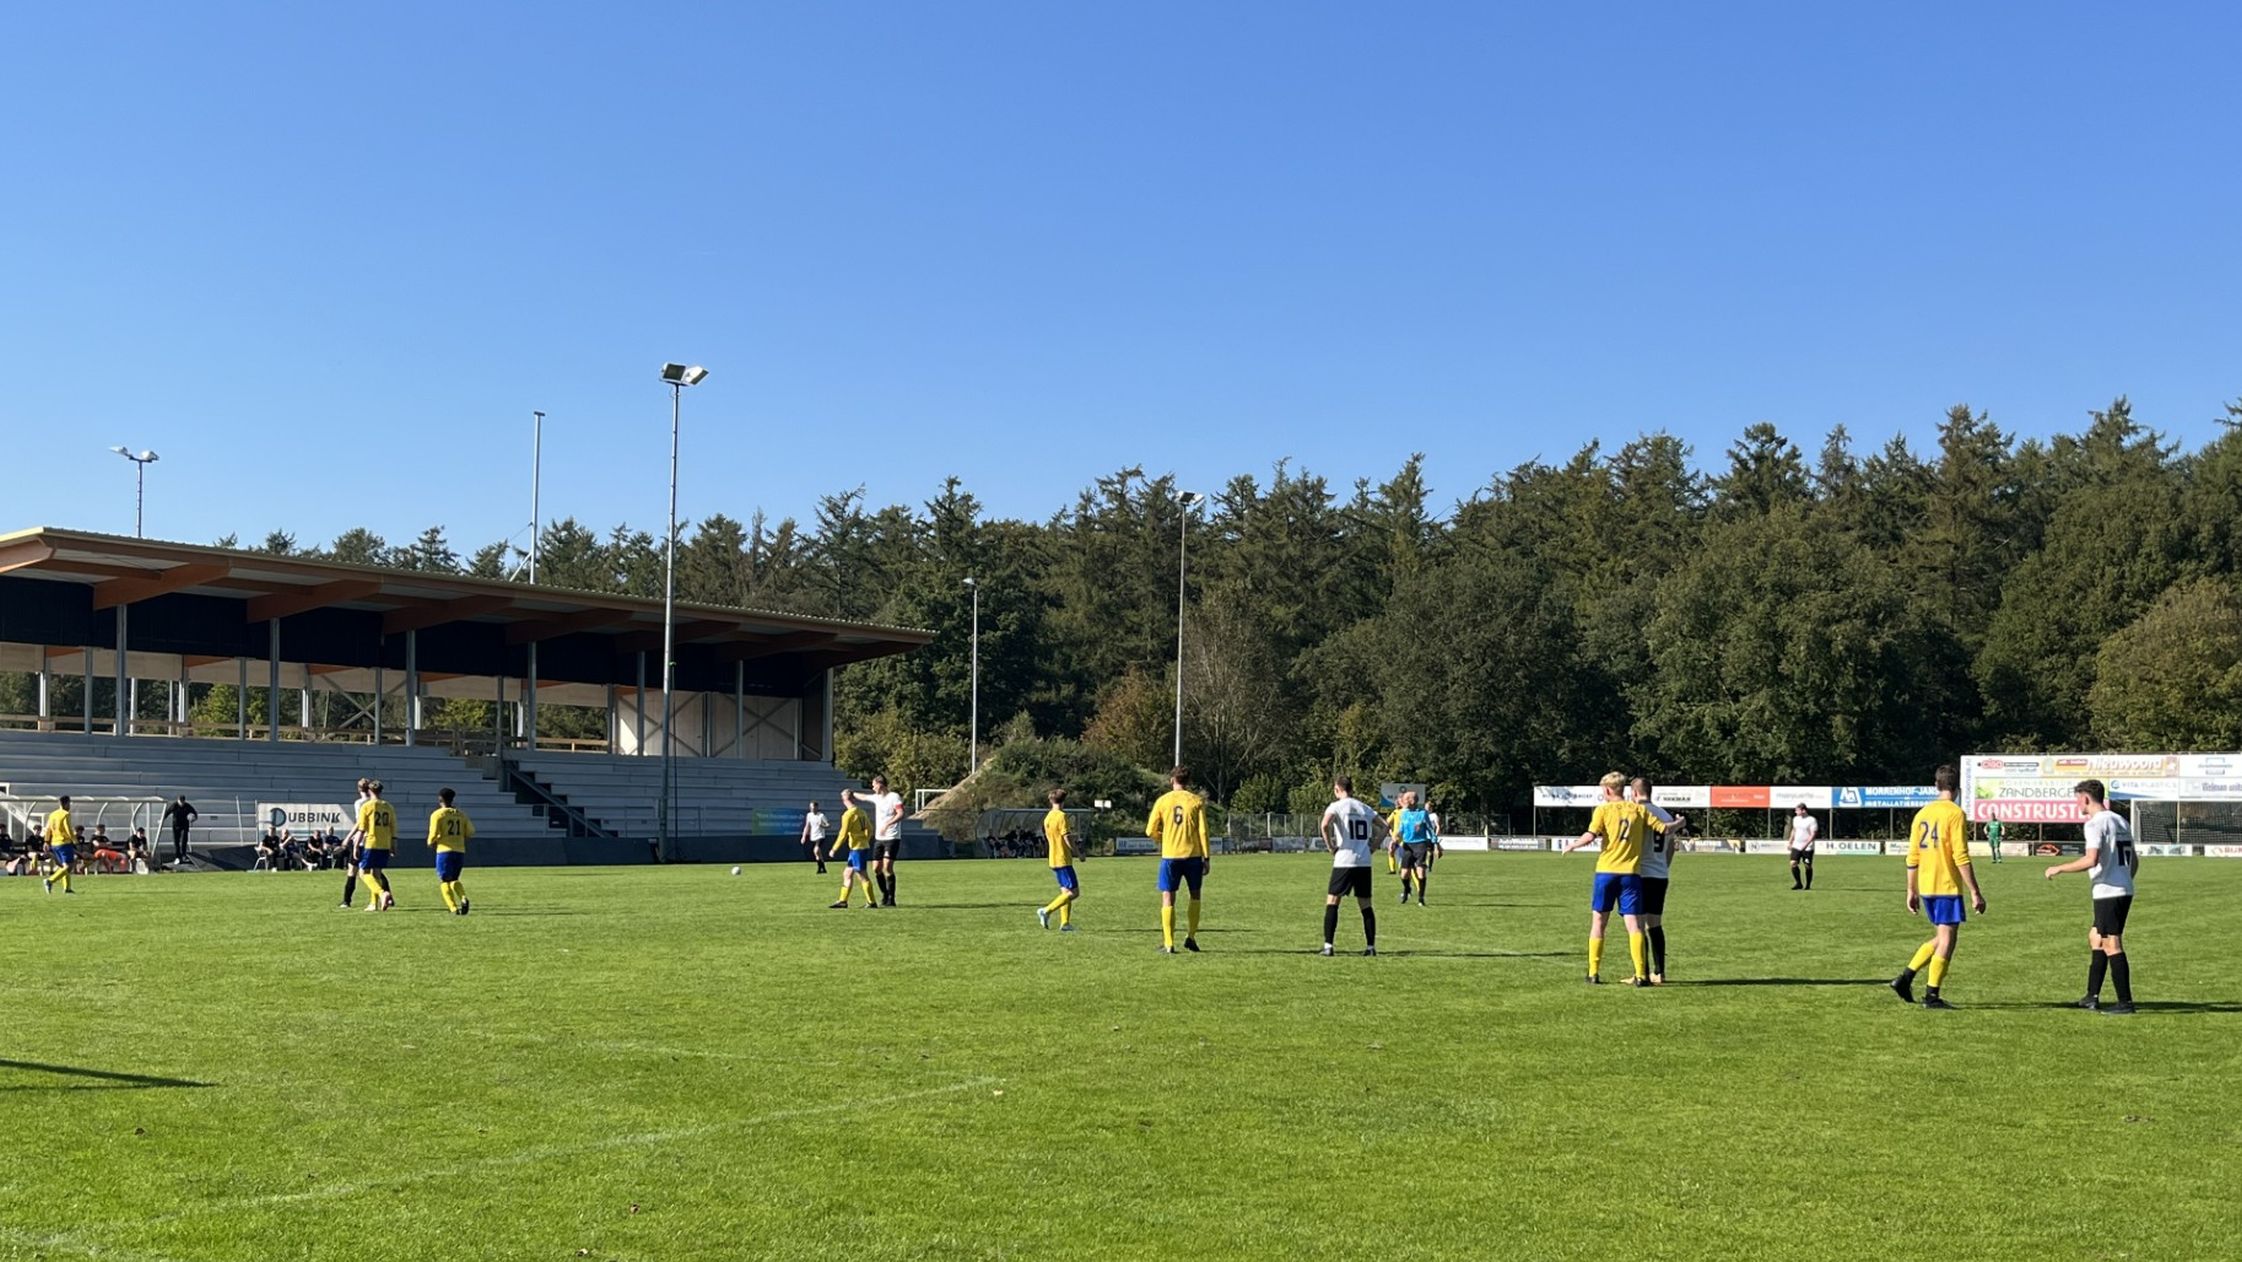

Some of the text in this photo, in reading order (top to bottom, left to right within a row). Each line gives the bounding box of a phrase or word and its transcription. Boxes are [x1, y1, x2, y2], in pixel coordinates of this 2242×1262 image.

[1865, 786, 1939, 796] MORRENHOF-JANS
[1999, 787, 2076, 798] ZANDBERGE
[270, 808, 341, 827] DUBBINK
[374, 811, 389, 826] 20
[1173, 805, 1183, 825] 6
[447, 819, 460, 836] 21
[1348, 819, 1368, 840] 10
[1919, 821, 1938, 848] 24
